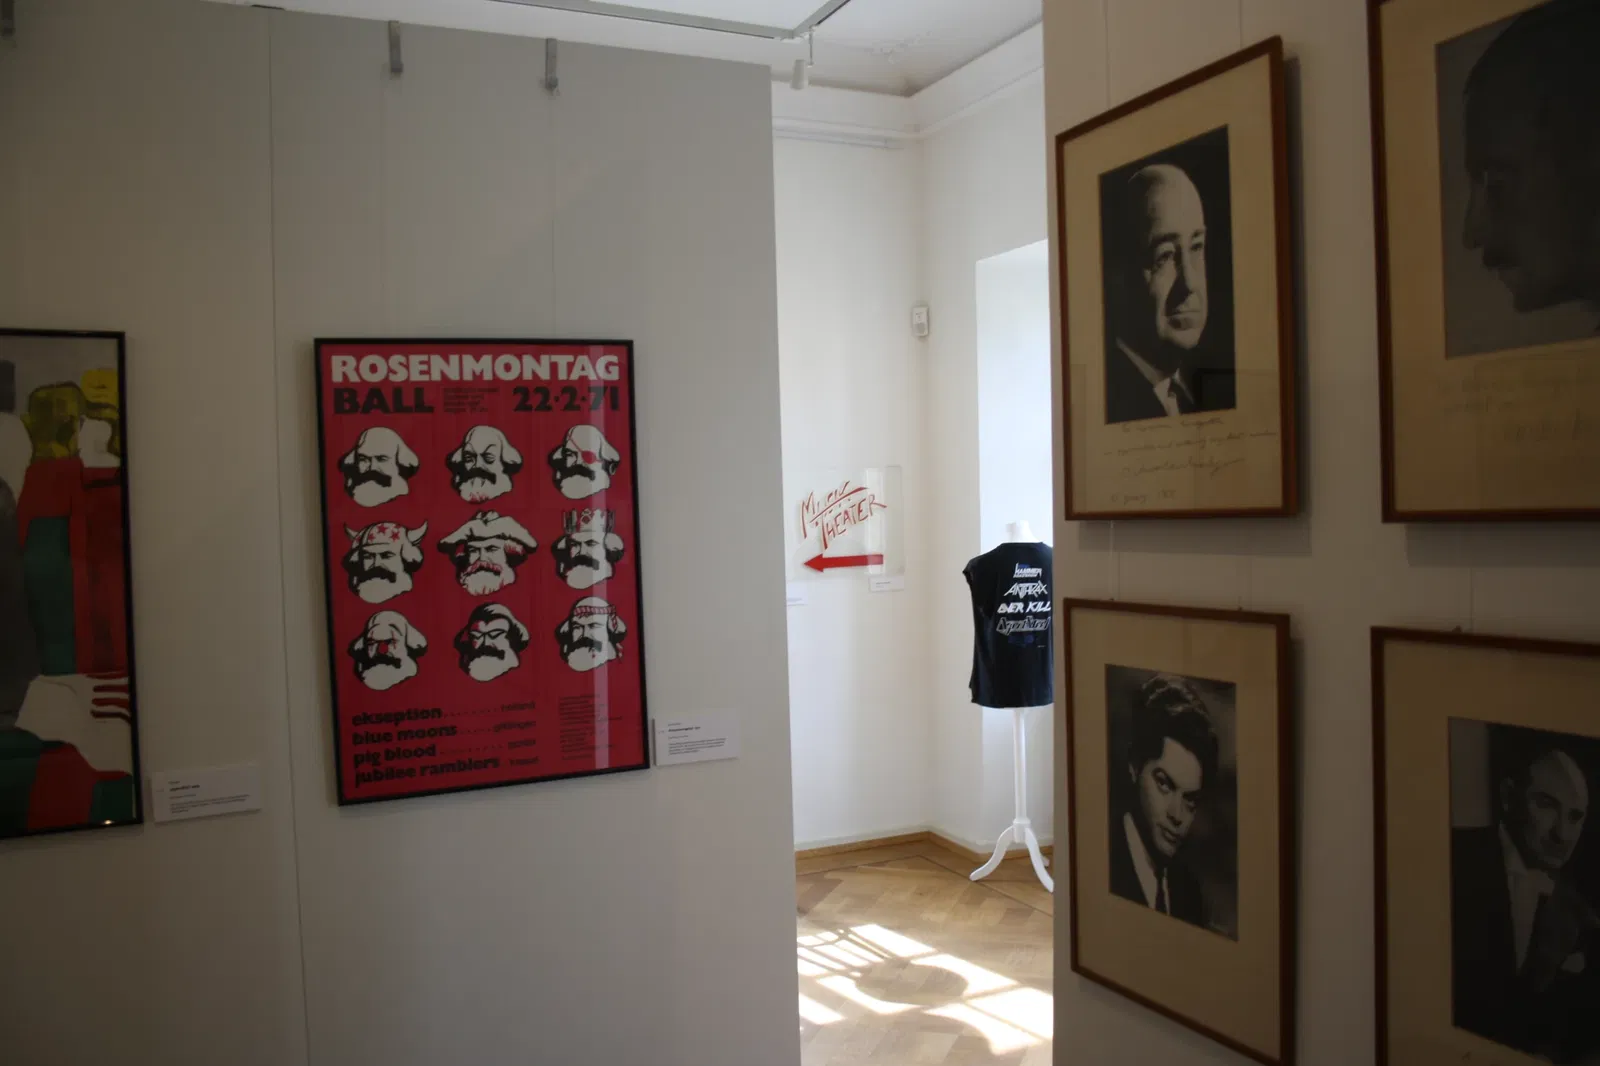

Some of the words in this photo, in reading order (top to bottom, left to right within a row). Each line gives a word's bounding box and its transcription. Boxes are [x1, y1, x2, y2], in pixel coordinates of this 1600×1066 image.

[331, 354, 620, 382] ROSENMONTAG
[333, 387, 435, 414] BALL
[821, 494, 888, 550] THEATER
[1003, 579, 1048, 599] ANTHRAX
[1026, 600, 1052, 613] KILL
[352, 707, 441, 726] ekseption
[352, 731, 393, 746] blue
[397, 725, 457, 741] moons
[353, 749, 381, 769] pig
[384, 743, 437, 761] blood
[355, 766, 416, 788] jubilee
[420, 757, 499, 776] ramblers
